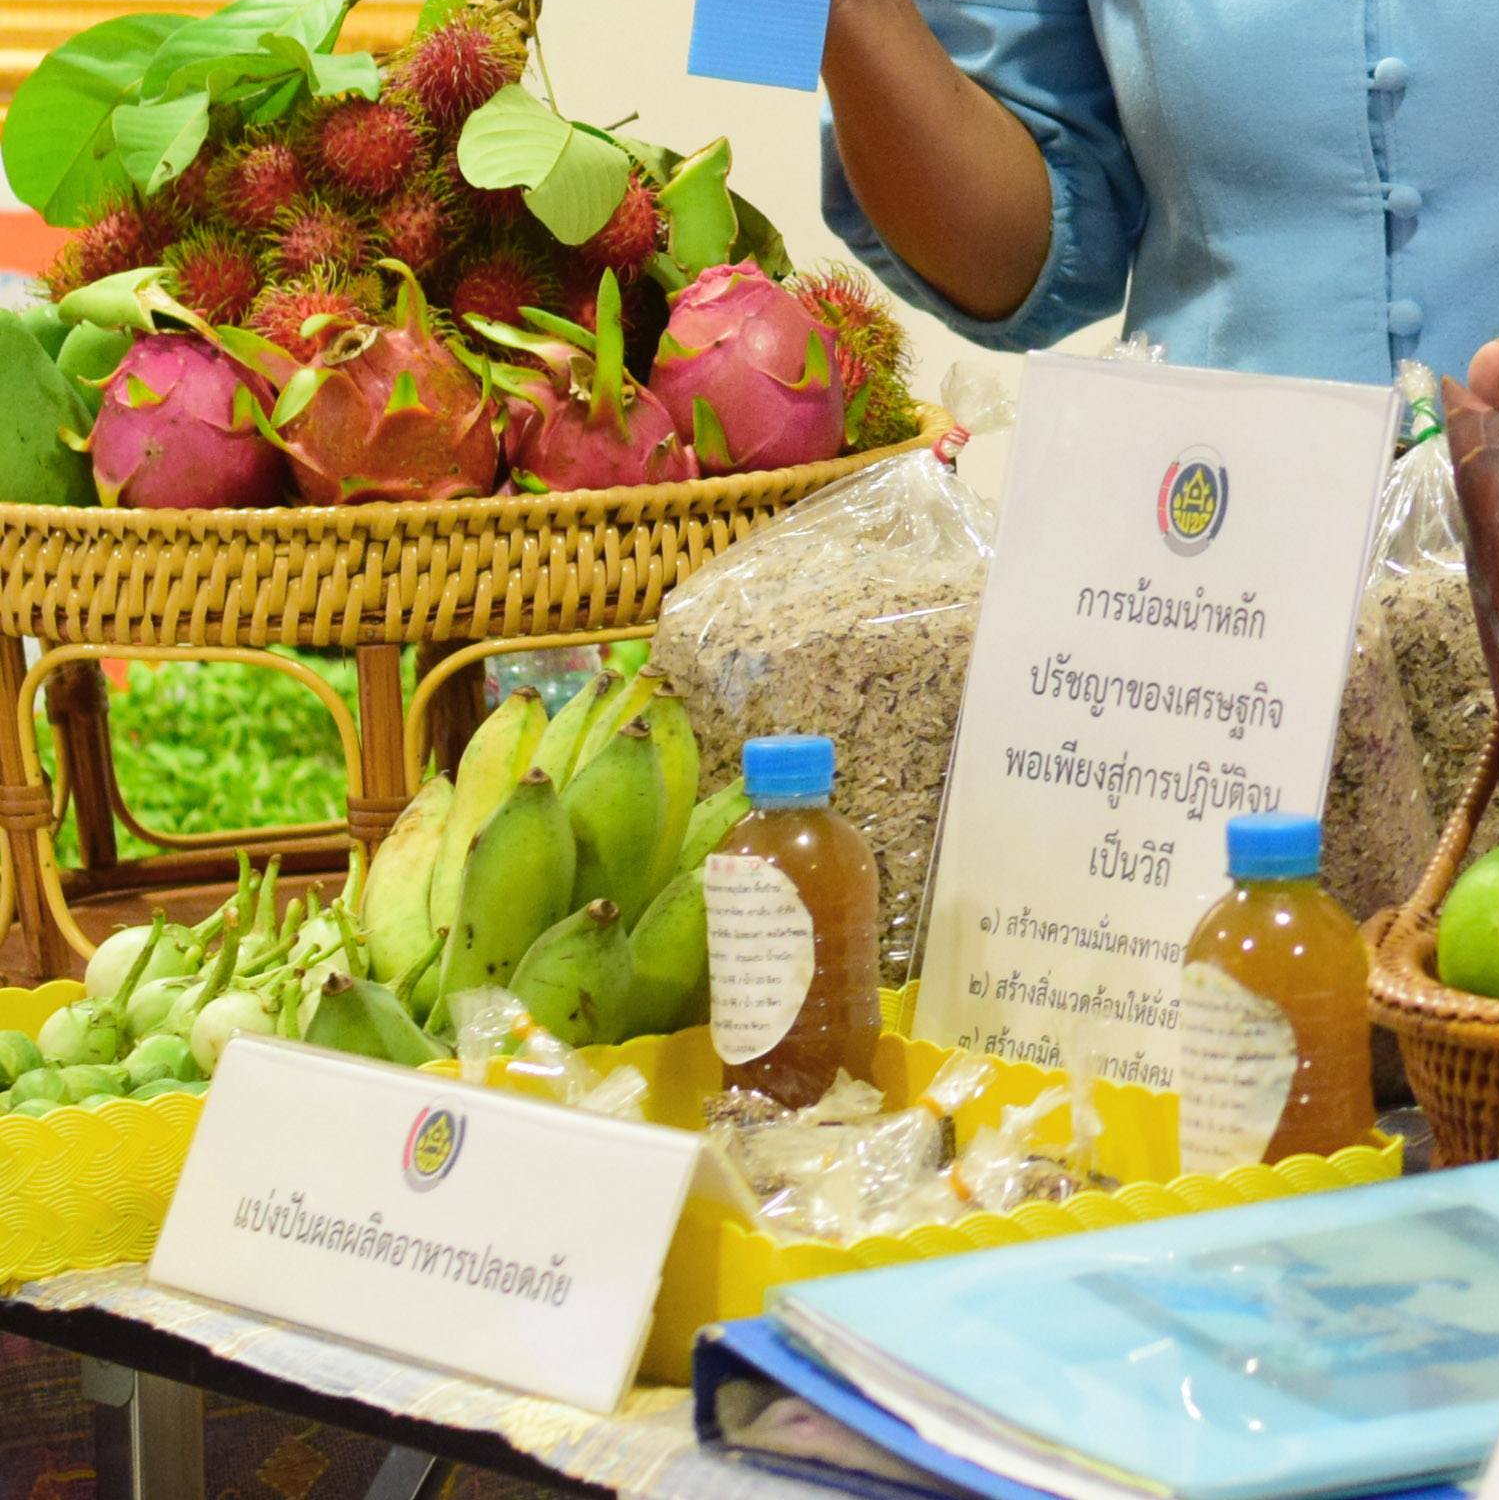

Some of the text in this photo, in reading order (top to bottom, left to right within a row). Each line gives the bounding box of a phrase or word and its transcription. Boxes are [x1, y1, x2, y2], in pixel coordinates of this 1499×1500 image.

[1075, 576, 1267, 640] การน้อมนำหลัก
[1029, 652, 1284, 740] ปรัชญาของเศรษฐกิจ
[1004, 739, 1282, 822] พอเพียงสู่การปฏิบัติจน
[1088, 828, 1176, 888] เป็นวิถี
[233, 1188, 573, 1307] แบ่งปันผลผลิตอาหารปลอดภัย
